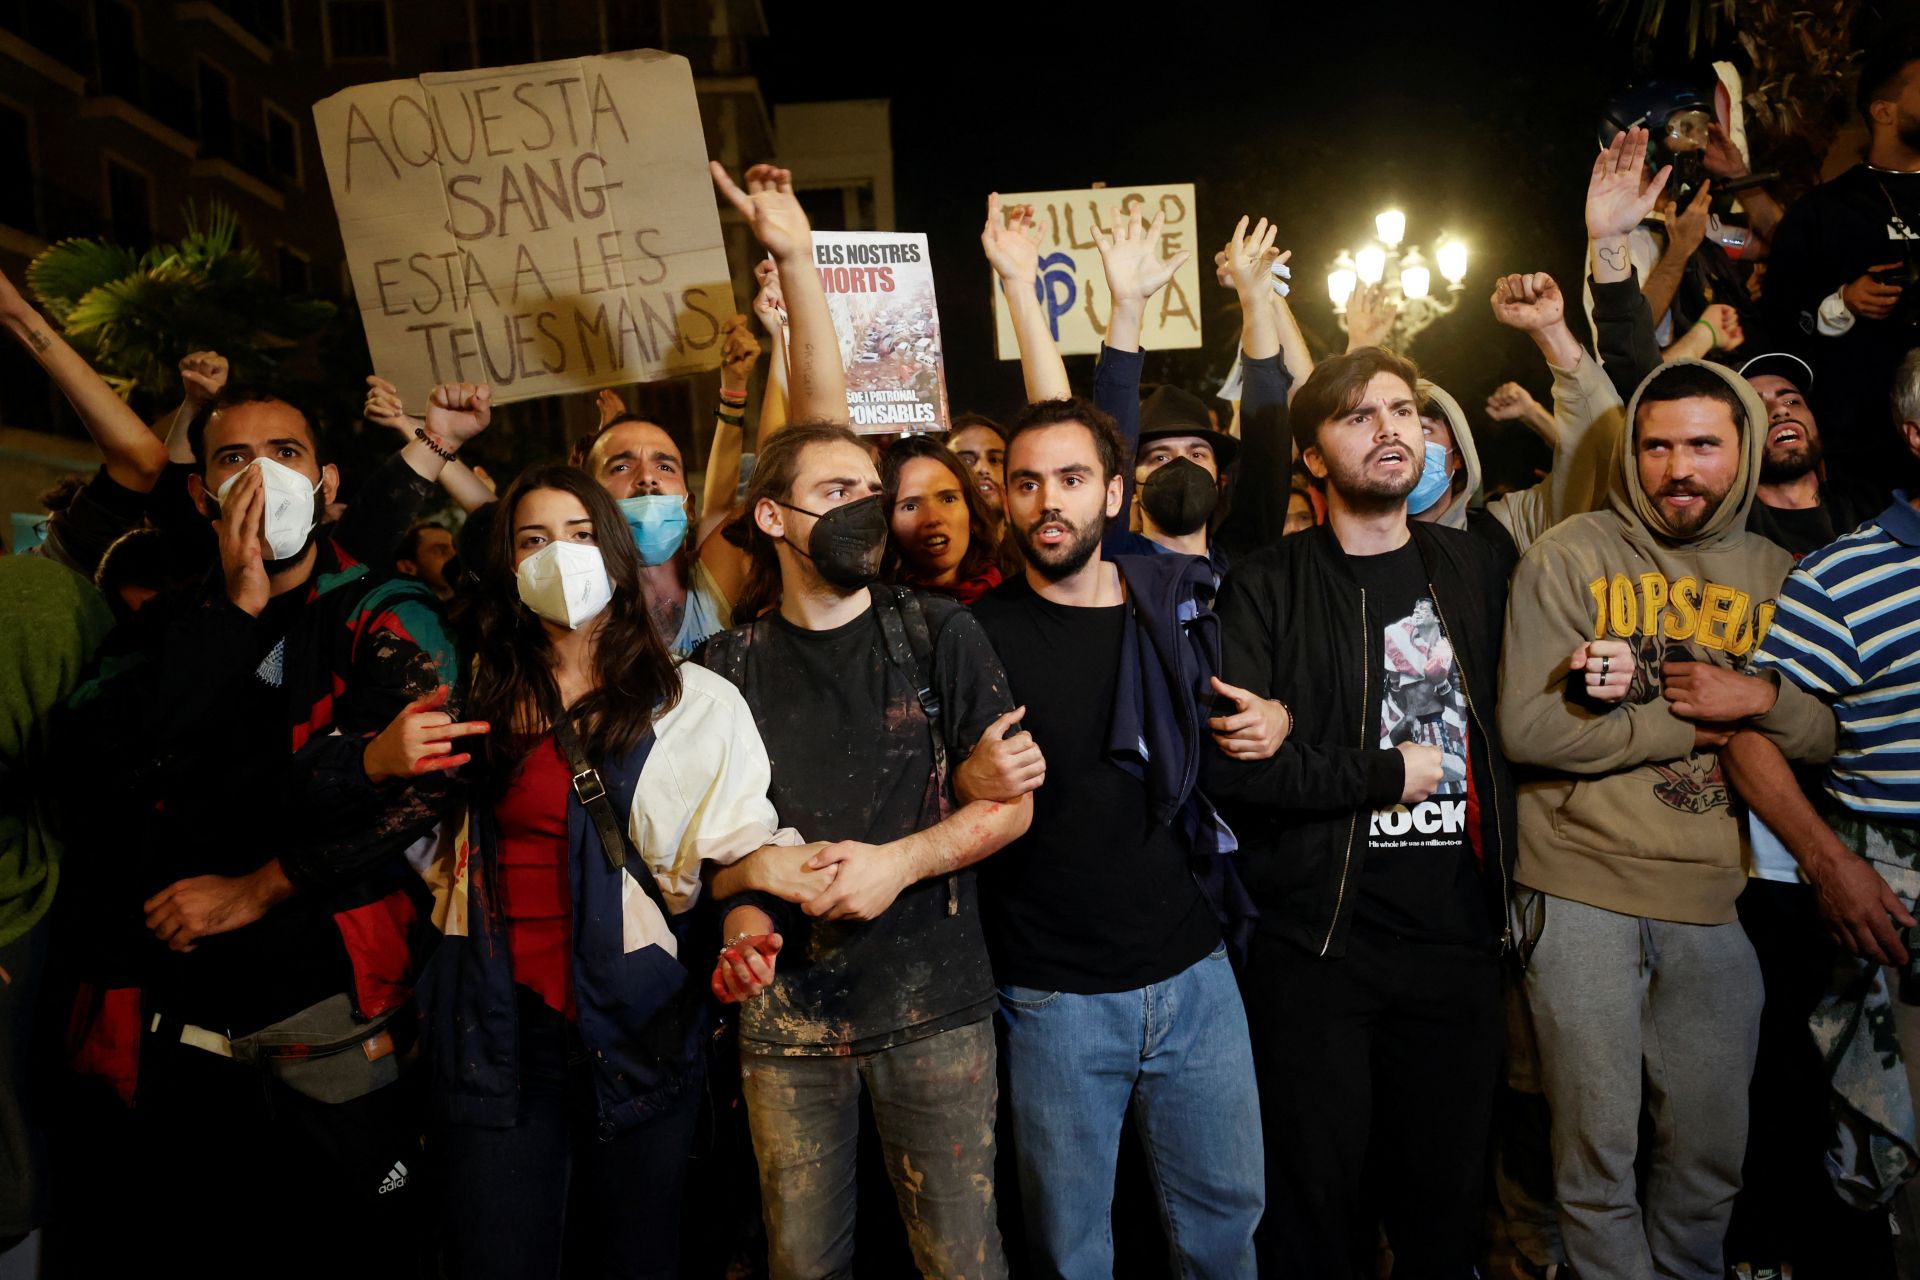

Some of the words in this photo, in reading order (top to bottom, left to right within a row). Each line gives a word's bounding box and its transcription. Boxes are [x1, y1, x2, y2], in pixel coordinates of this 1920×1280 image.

[343, 73, 629, 193] AQUESTA
[443, 151, 624, 241] SANG
[511, 243, 553, 302] A
[573, 227, 667, 295] LES
[816, 244, 844, 265] ELS
[847, 243, 921, 264] NOSTRES
[816, 266, 896, 294] MORTS
[573, 287, 720, 378] MANS
[1368, 840, 1379, 848] His
